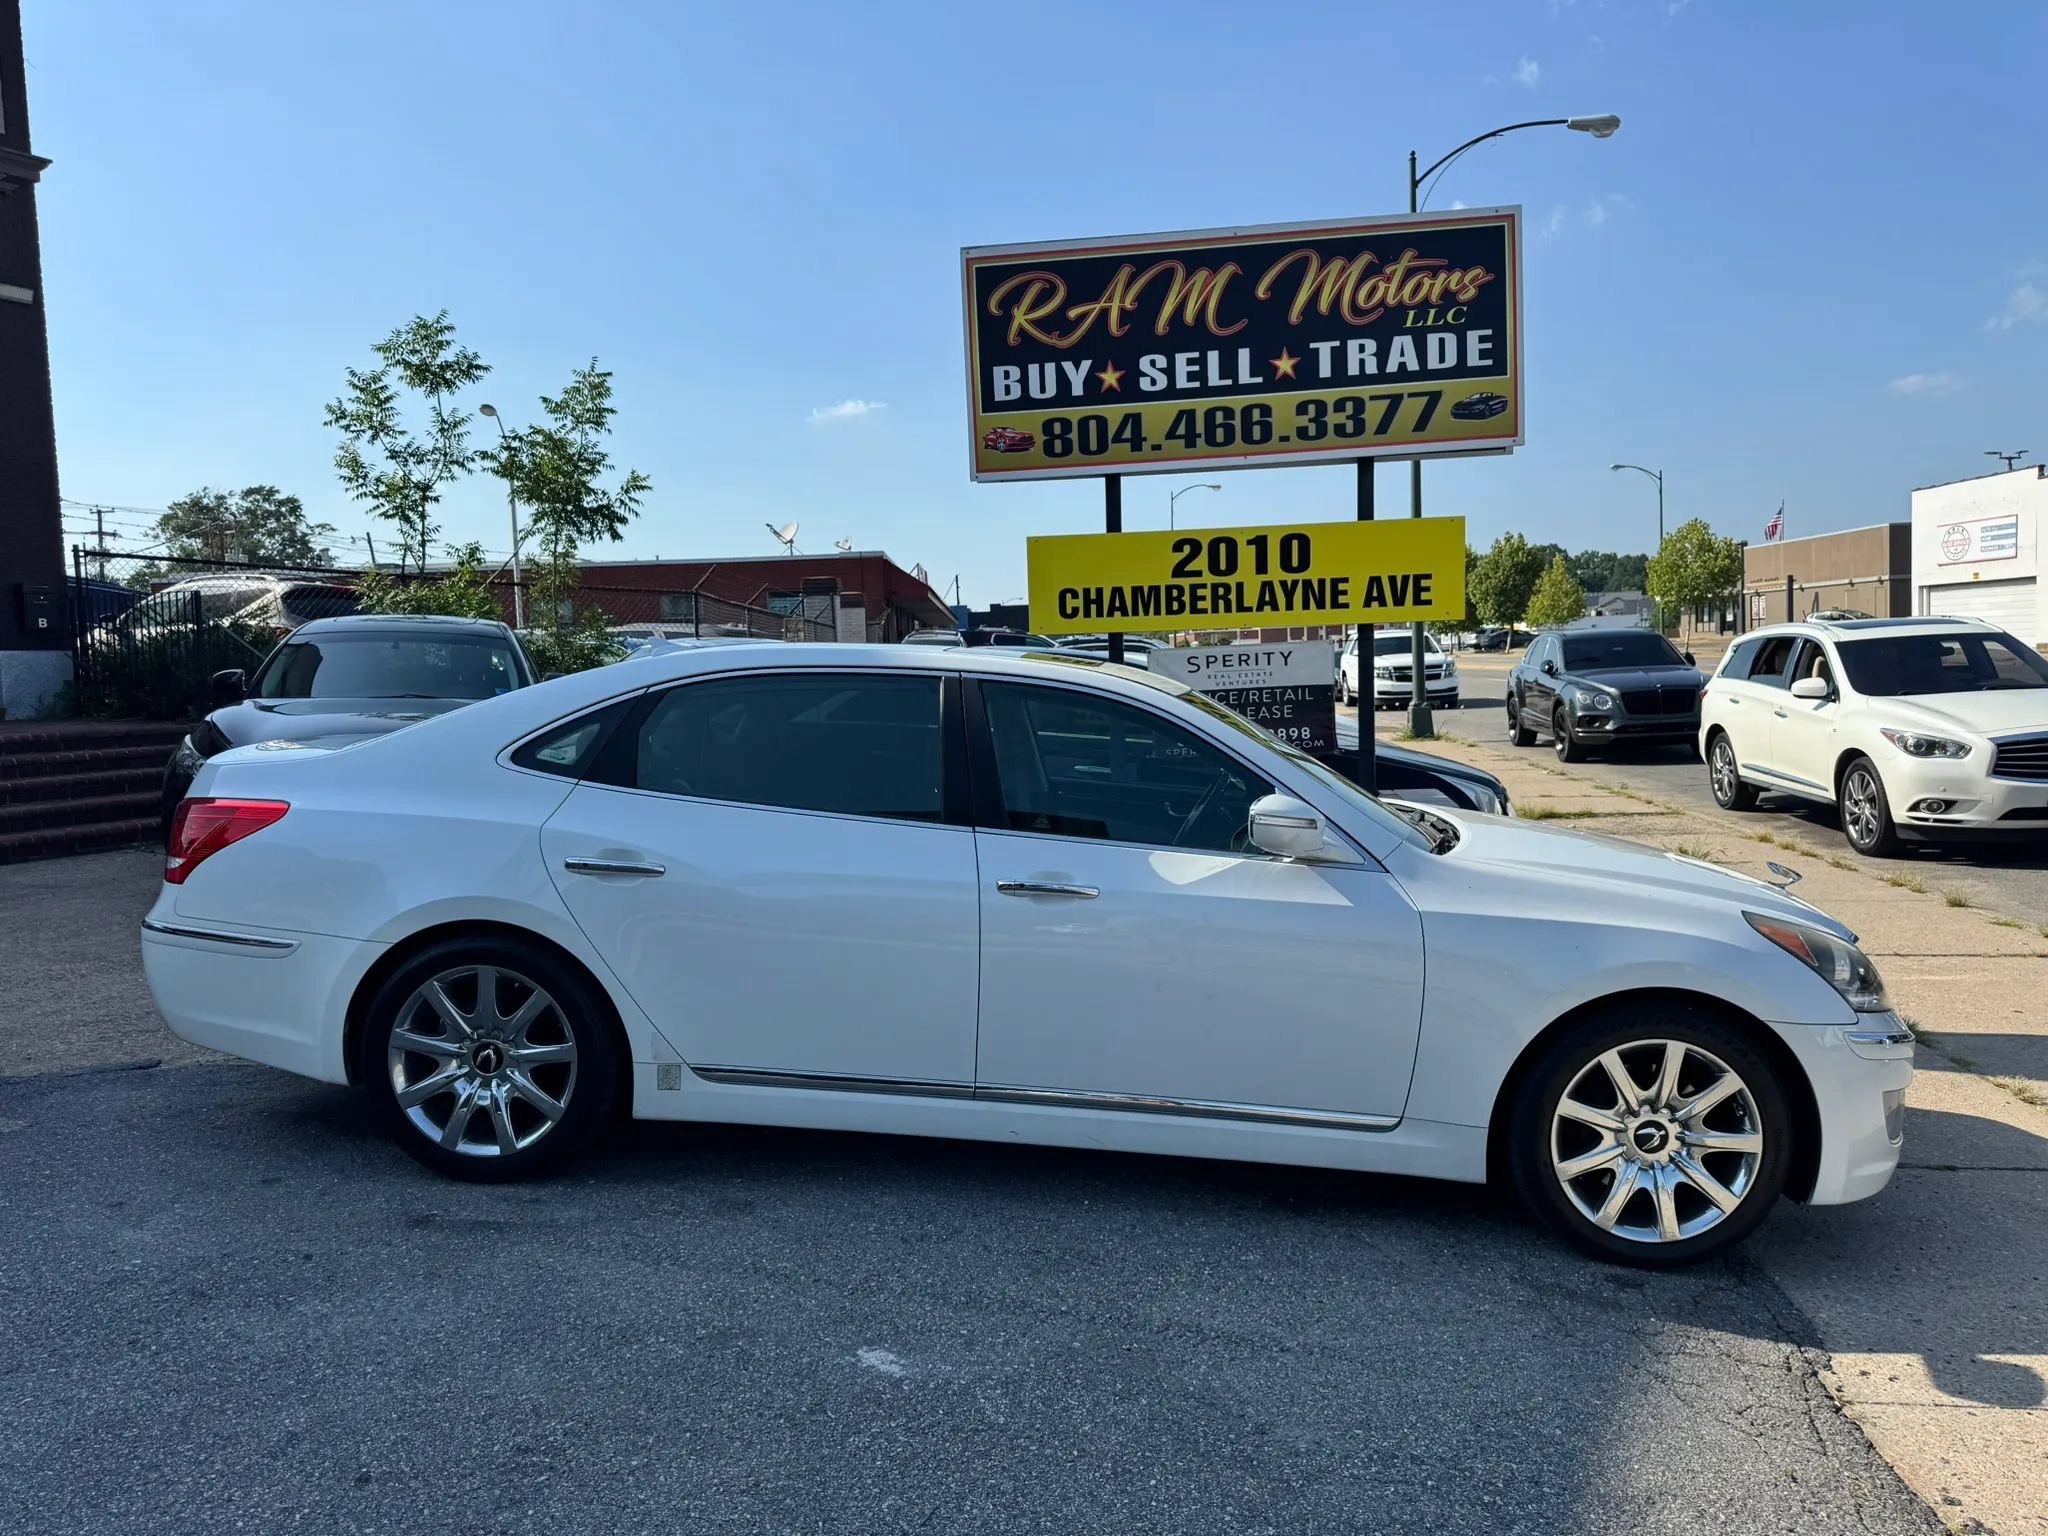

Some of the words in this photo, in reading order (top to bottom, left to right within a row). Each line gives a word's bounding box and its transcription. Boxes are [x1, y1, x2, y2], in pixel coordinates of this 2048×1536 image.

[987, 259, 1248, 348] RAM
[1255, 247, 1495, 326] Motors
[1402, 306, 1468, 328] LLC
[993, 359, 1093, 402] BUY
[1139, 347, 1264, 392] SELL
[1309, 329, 1494, 378] TRADE
[1041, 390, 1443, 459] 804.466.3377
[1171, 532, 1311, 578] 2010
[1058, 577, 1350, 619] CHAMBERLAYNE
[1363, 573, 1433, 608] AVE
[38, 617, 48, 628] B
[1187, 651, 1293, 674] SPERITY
[1215, 679, 1267, 687] VENTURES
